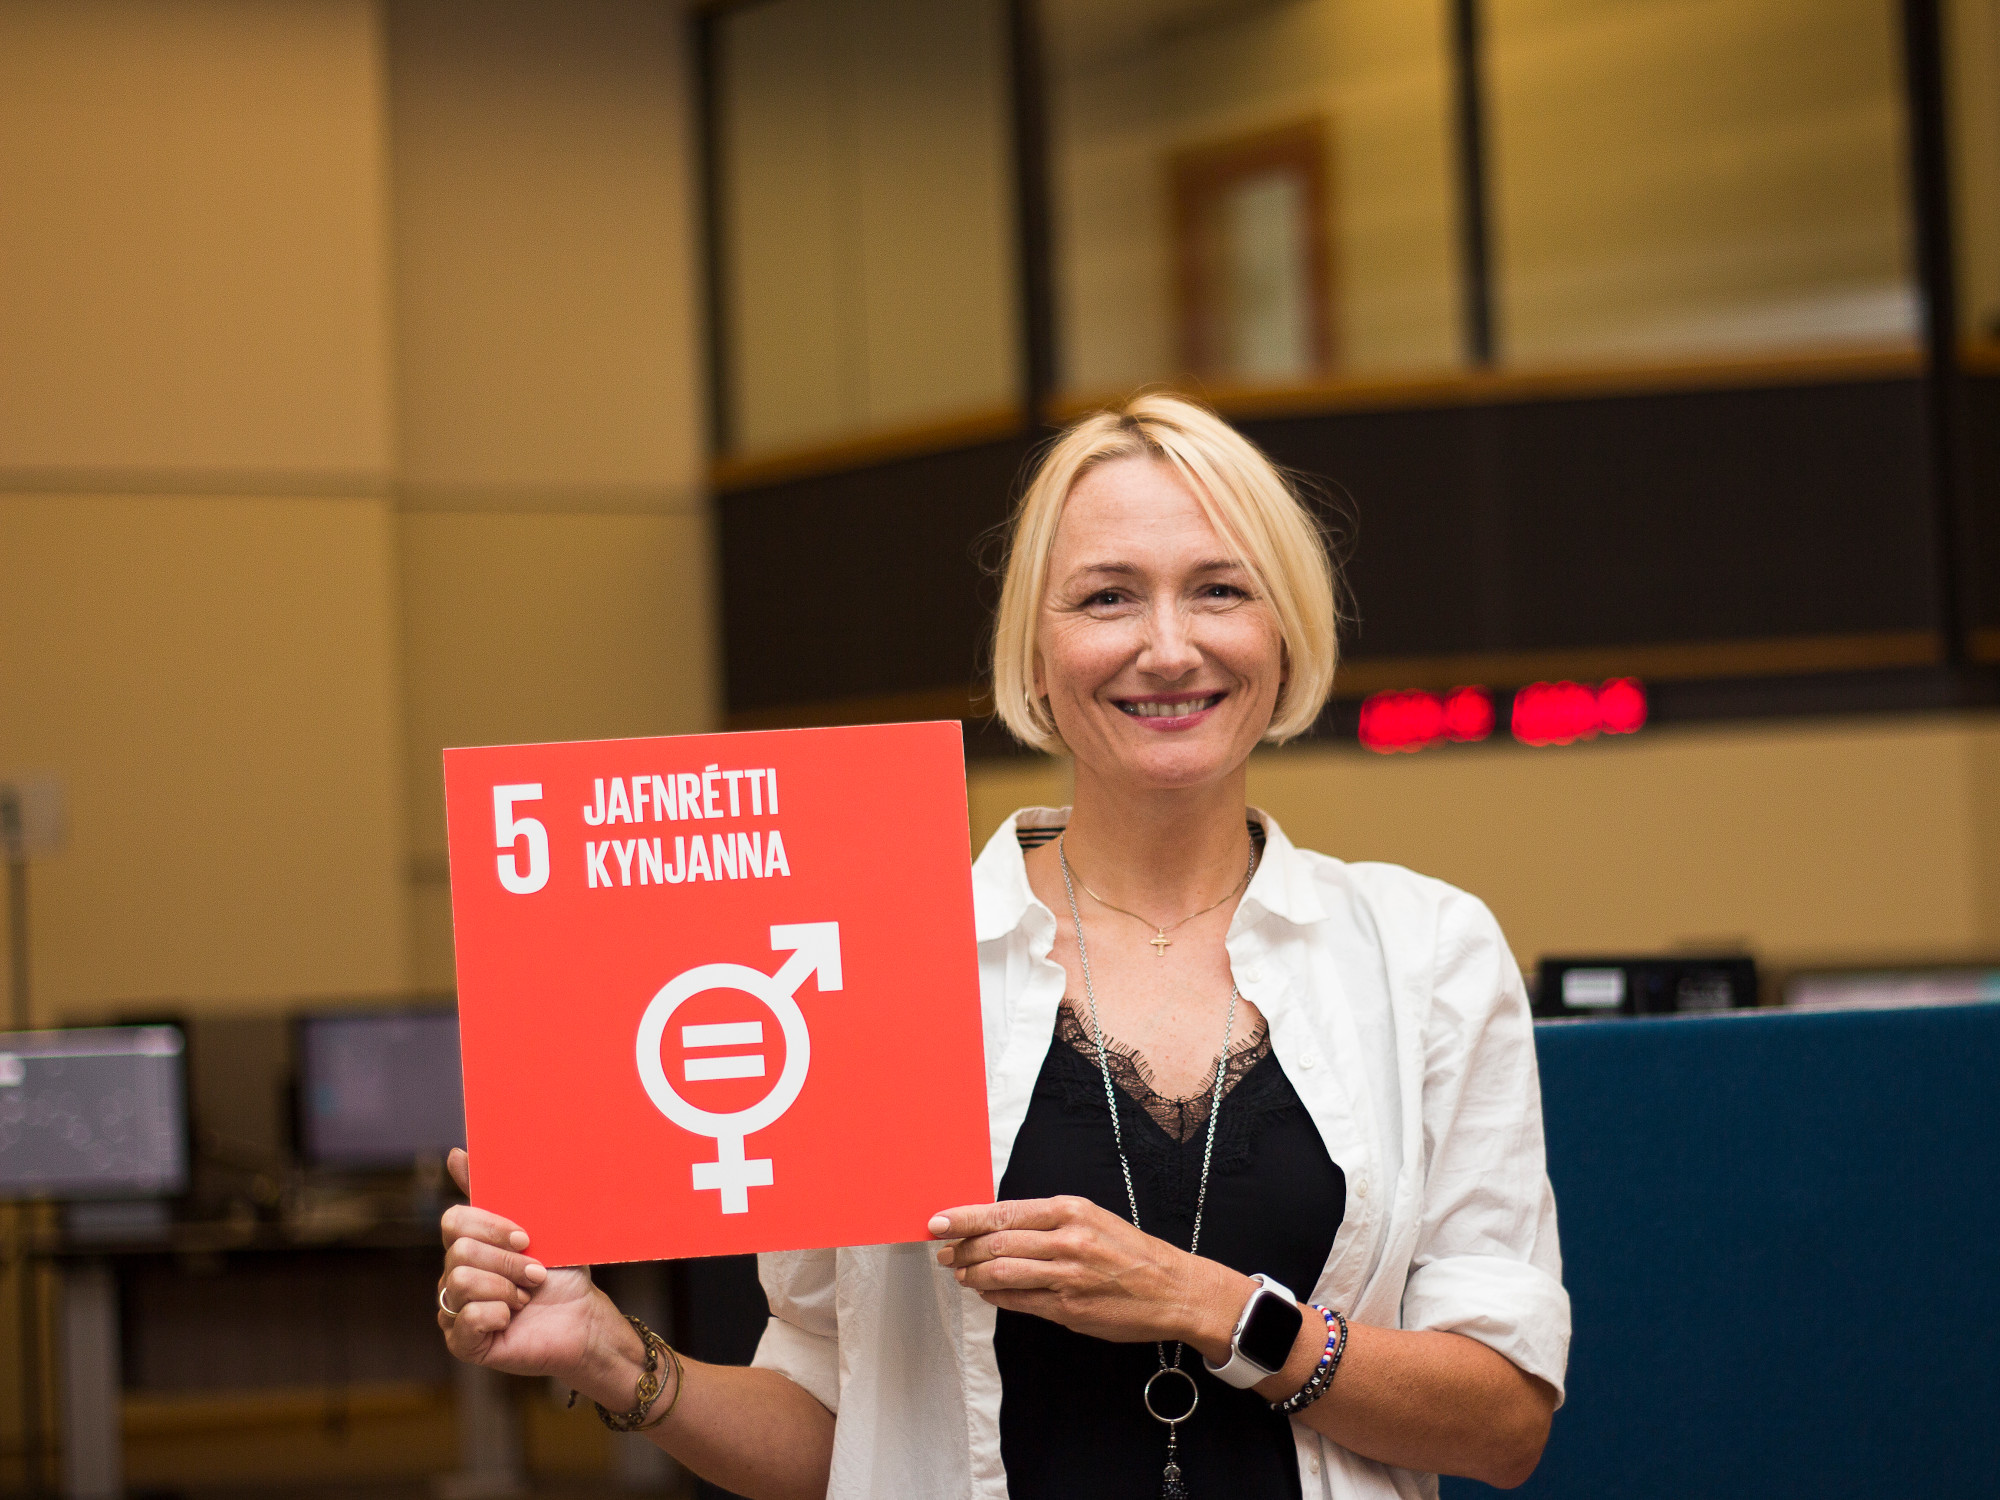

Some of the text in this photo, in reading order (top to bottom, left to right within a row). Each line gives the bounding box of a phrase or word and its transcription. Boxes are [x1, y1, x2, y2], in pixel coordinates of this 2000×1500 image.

[583, 763, 779, 826] JAFNRÉTTI
[492, 782, 551, 895] 5
[585, 829, 791, 889] KYNJANNA
